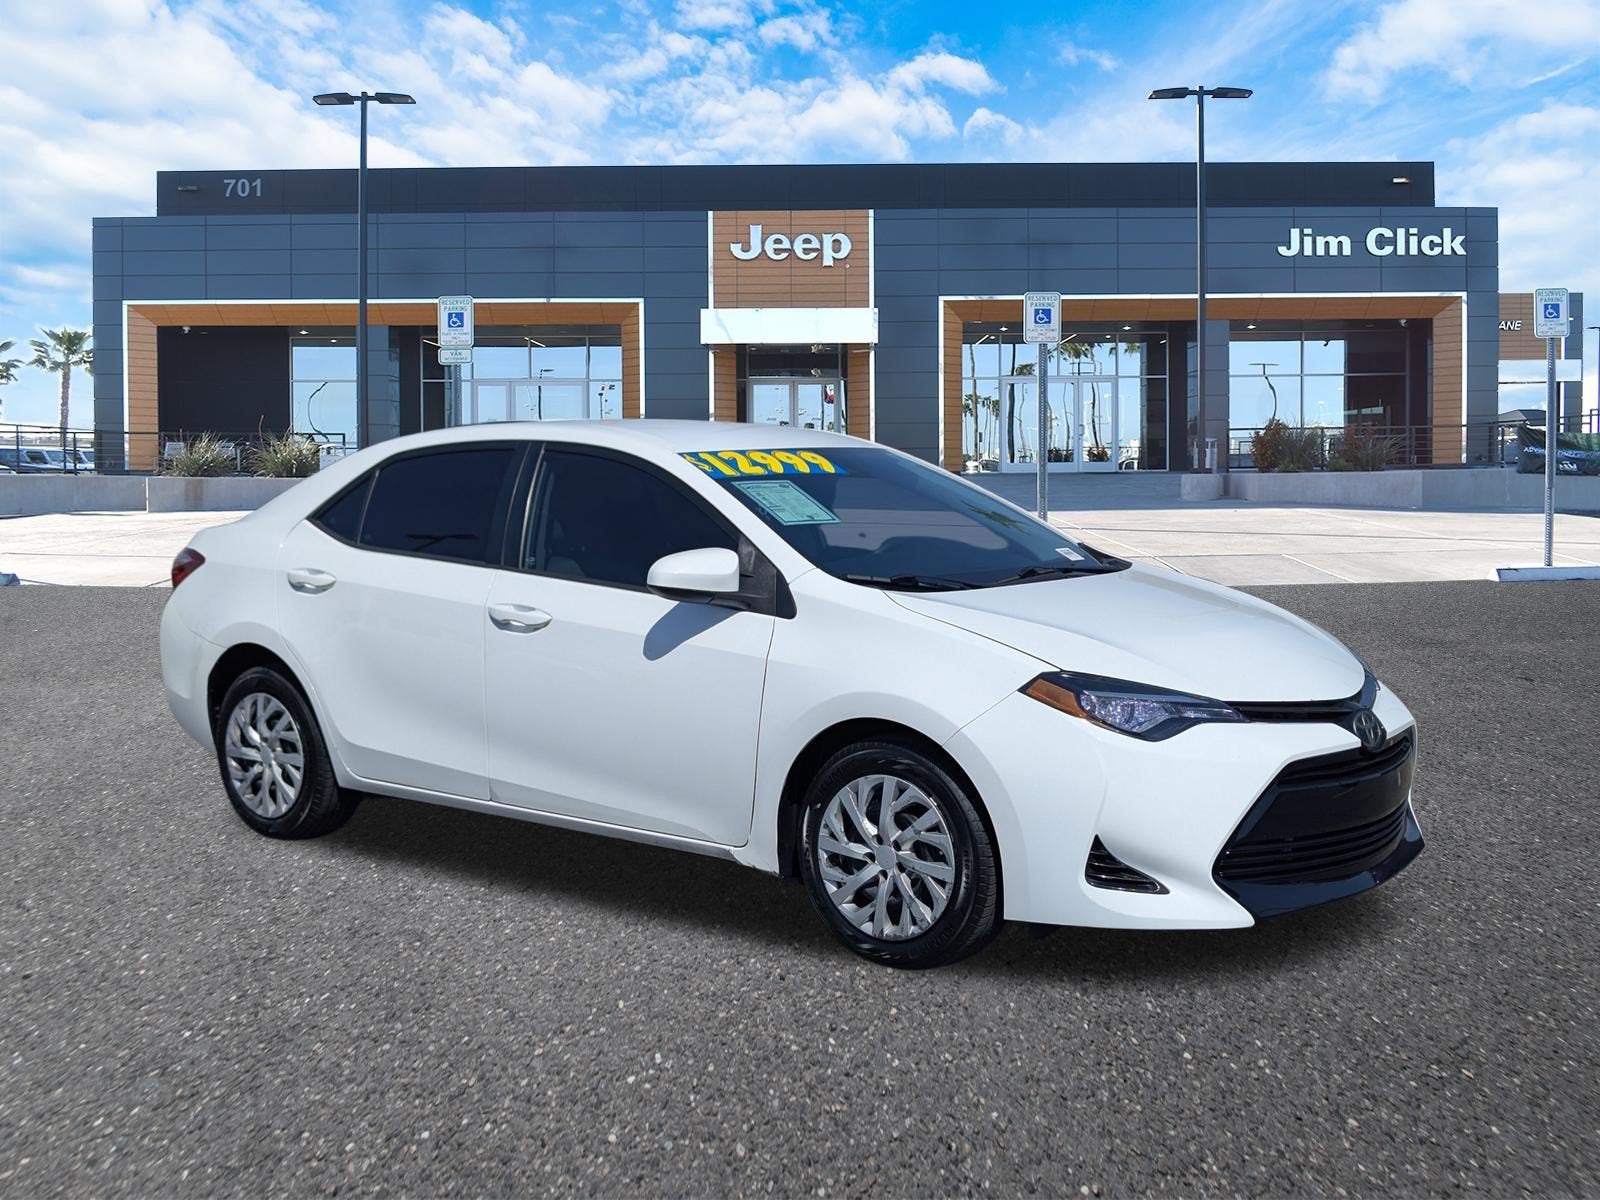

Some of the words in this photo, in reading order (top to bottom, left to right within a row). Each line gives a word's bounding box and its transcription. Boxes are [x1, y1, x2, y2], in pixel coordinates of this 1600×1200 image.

[223, 178, 262, 197] 701
[730, 223, 852, 267] Jeep
[1277, 227, 1352, 257] Jim
[1365, 227, 1467, 257] Click
[1499, 320, 1522, 331] ANE
[683, 450, 836, 477] $12999
